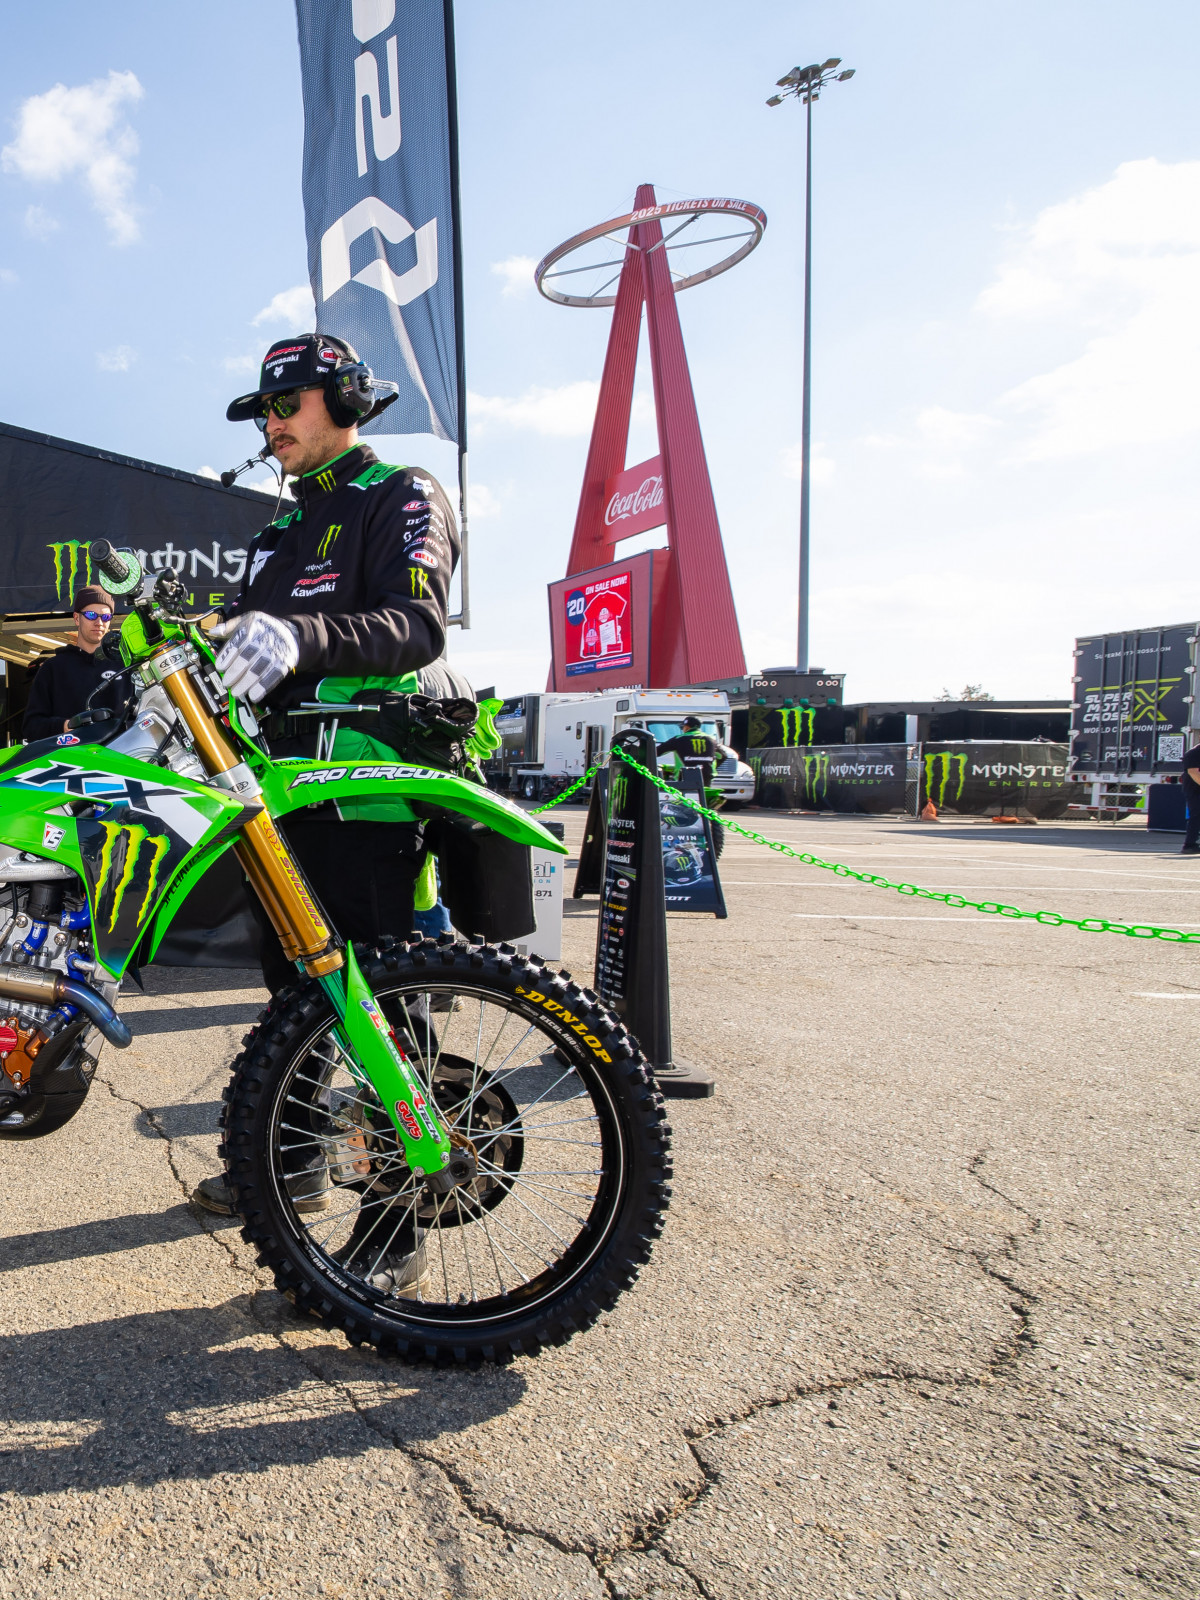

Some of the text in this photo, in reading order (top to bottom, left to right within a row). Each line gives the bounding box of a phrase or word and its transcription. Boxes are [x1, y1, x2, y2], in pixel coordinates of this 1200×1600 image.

[630, 199, 748, 221] 2025 TICKETS ON SALE
[265, 354, 299, 371] Kawasaki
[604, 475, 665, 526] Coca-Cola
[406, 513, 444, 529] DUNLOP
[414, 552, 435, 565] BELL
[290, 582, 337, 598] Kawasaki
[585, 585, 594, 596] ON
[595, 580, 610, 593] SALE
[566, 597, 585, 617] $20
[287, 766, 459, 791] PRO CIRCUIT
[761, 763, 791, 776] MONSTER
[830, 762, 895, 777] MONSTER
[972, 762, 1070, 779] MONSTE
[13, 760, 208, 815] KX
[607, 818, 636, 829] ONSTER
[279, 856, 323, 927] SHOWA
[360, 999, 385, 1030] JE
[523, 990, 613, 1063] DUNLOP
[539, 1015, 563, 1035] EXCEL
[398, 1100, 423, 1137] GUTS
[325, 1268, 349, 1289] EXCEL
